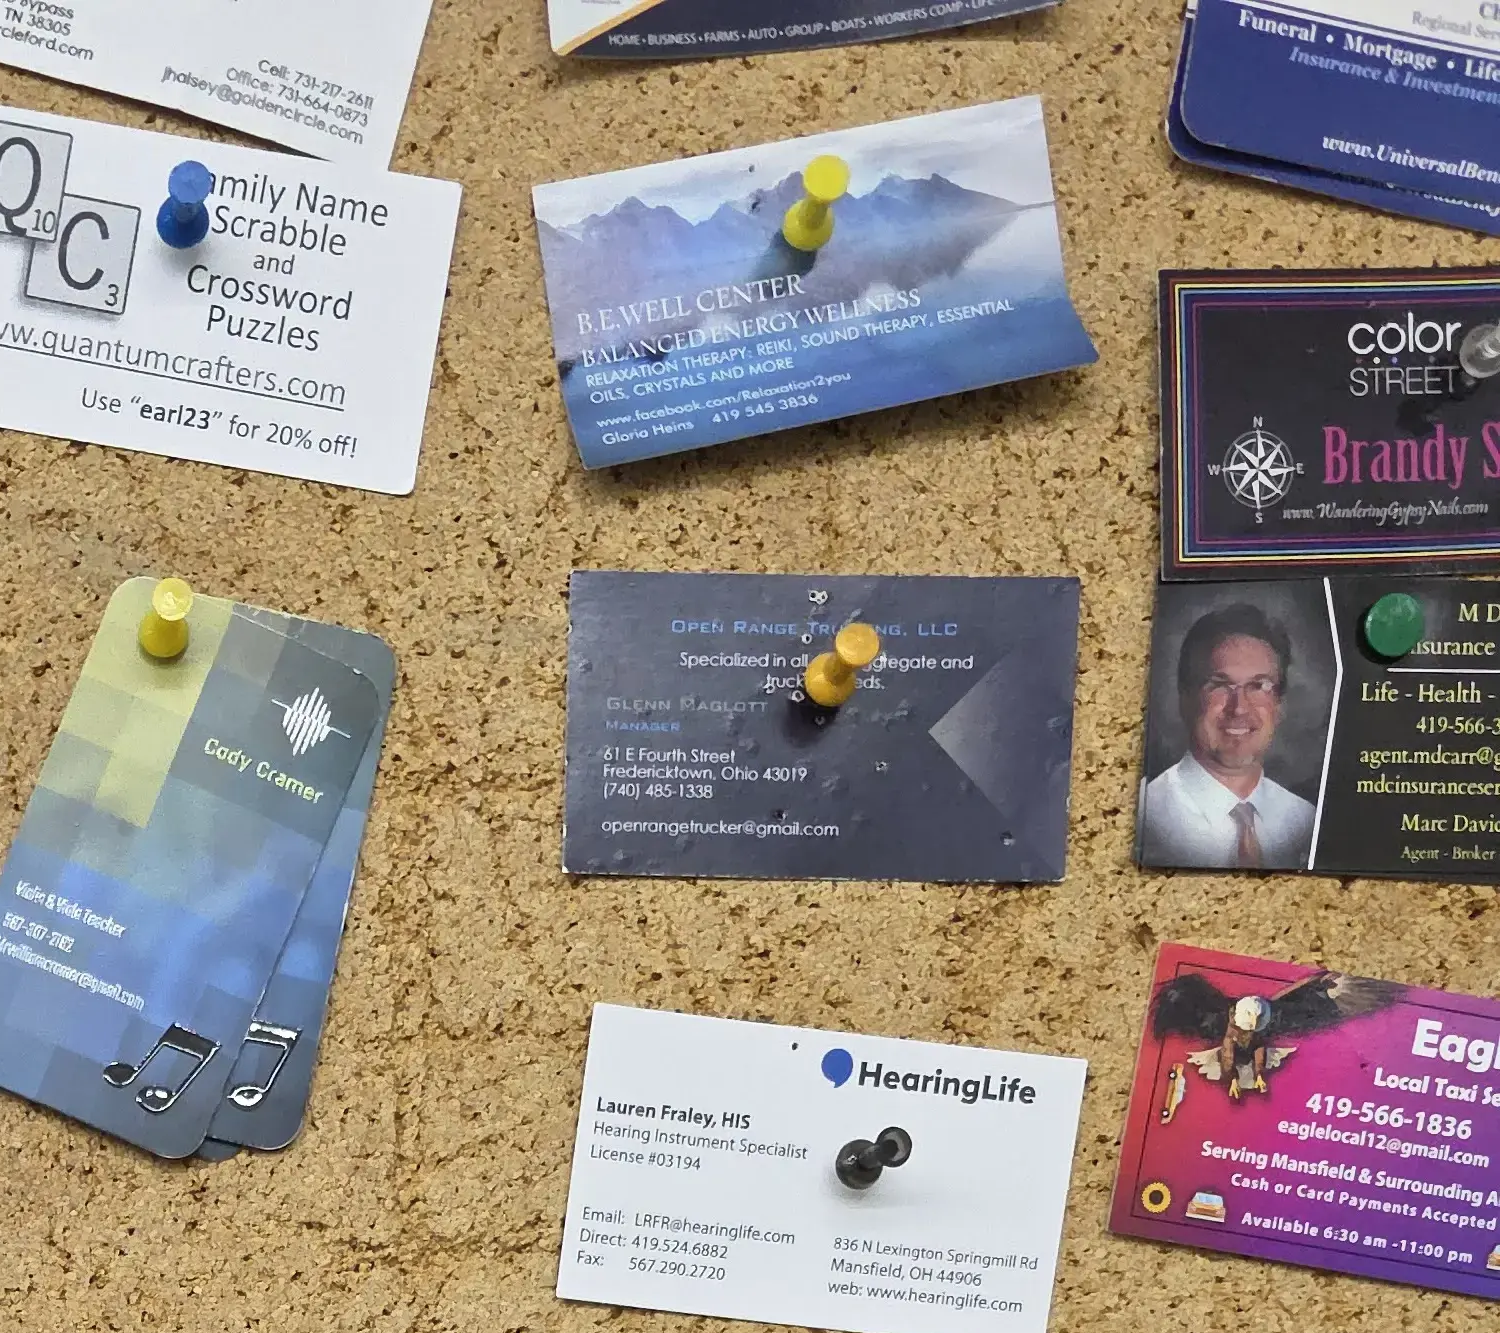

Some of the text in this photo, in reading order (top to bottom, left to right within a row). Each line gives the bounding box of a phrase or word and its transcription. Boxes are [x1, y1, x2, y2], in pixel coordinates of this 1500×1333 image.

[1238, 10, 1437, 70] Funeral Mortgage
[226, 66, 368, 128] Office: 731-664-0873
[258, 59, 374, 110] Cell: 731-217-2611
[295, 182, 388, 228] Name
[58, 212, 109, 291] C
[212, 207, 346, 258] Scrabble
[253, 252, 294, 276] and
[187, 265, 353, 321] Crossword
[696, 272, 805, 312] CENTER
[206, 305, 319, 352] Puzzles
[582, 289, 922, 369] BALANCED ENERGY WELLNESS
[1348, 312, 1461, 355] color
[1349, 365, 1459, 397] STREET
[82, 388, 122, 414] Use
[228, 416, 260, 440] for
[266, 422, 312, 450] 20%
[318, 433, 357, 458] off!
[1324, 424, 1467, 490] Brandy
[204, 737, 323, 805] Cody Cramer
[604, 748, 735, 764] 61 E Fourth Street
[602, 819, 839, 838] openrangetrucker@gmail.com
[859, 1062, 1036, 1105] HearingLife
[597, 1099, 751, 1130] Lauren Fraley, HIS
[1306, 1093, 1472, 1140] 419-566-1836
[590, 1145, 701, 1171] License #03194
[594, 1121, 808, 1160] Hearing Instrument Specialist
[1278, 1119, 1489, 1168] eaglelocal12@gmail.com
[1231, 1172, 1496, 1231] Cash or Card Payments Accepted
[834, 1236, 1038, 1271] 836 N Lexington Springmill Rd
